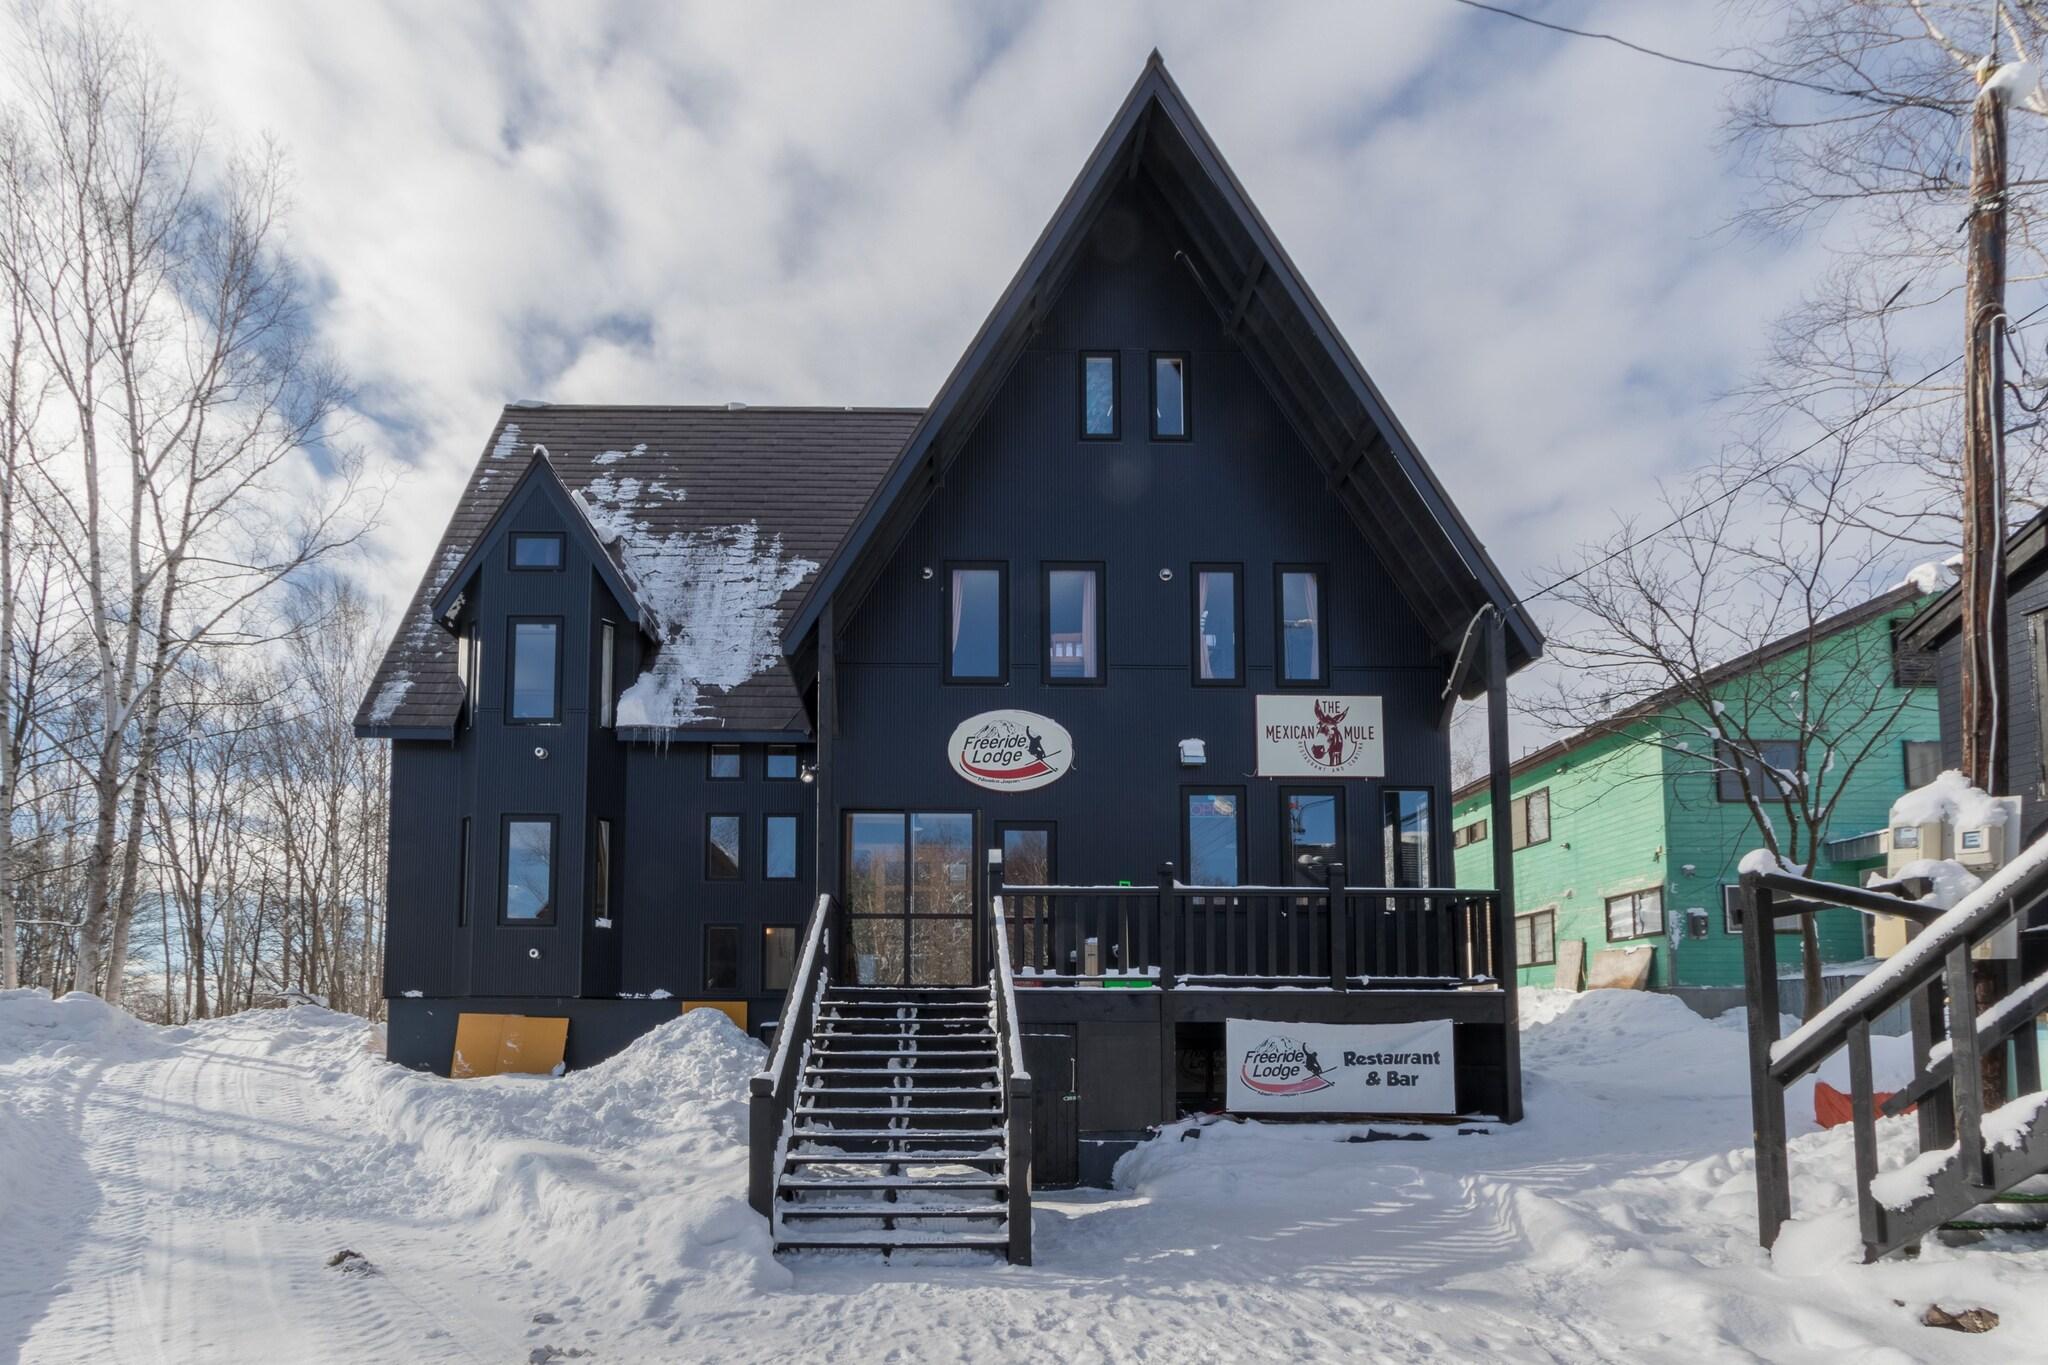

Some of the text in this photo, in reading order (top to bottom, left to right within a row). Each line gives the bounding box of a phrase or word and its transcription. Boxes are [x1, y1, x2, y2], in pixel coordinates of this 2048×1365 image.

[1322, 701, 1341, 714] THE
[964, 735, 1027, 750] Freeride
[1266, 725, 1375, 744] MEXICAN MULE
[972, 750, 1023, 766] Lodge
[1244, 1050, 1304, 1064] Freeride
[1343, 1051, 1441, 1067] Restaurant
[1252, 1064, 1300, 1080] Lodge
[1365, 1071, 1419, 1087] & Bar
